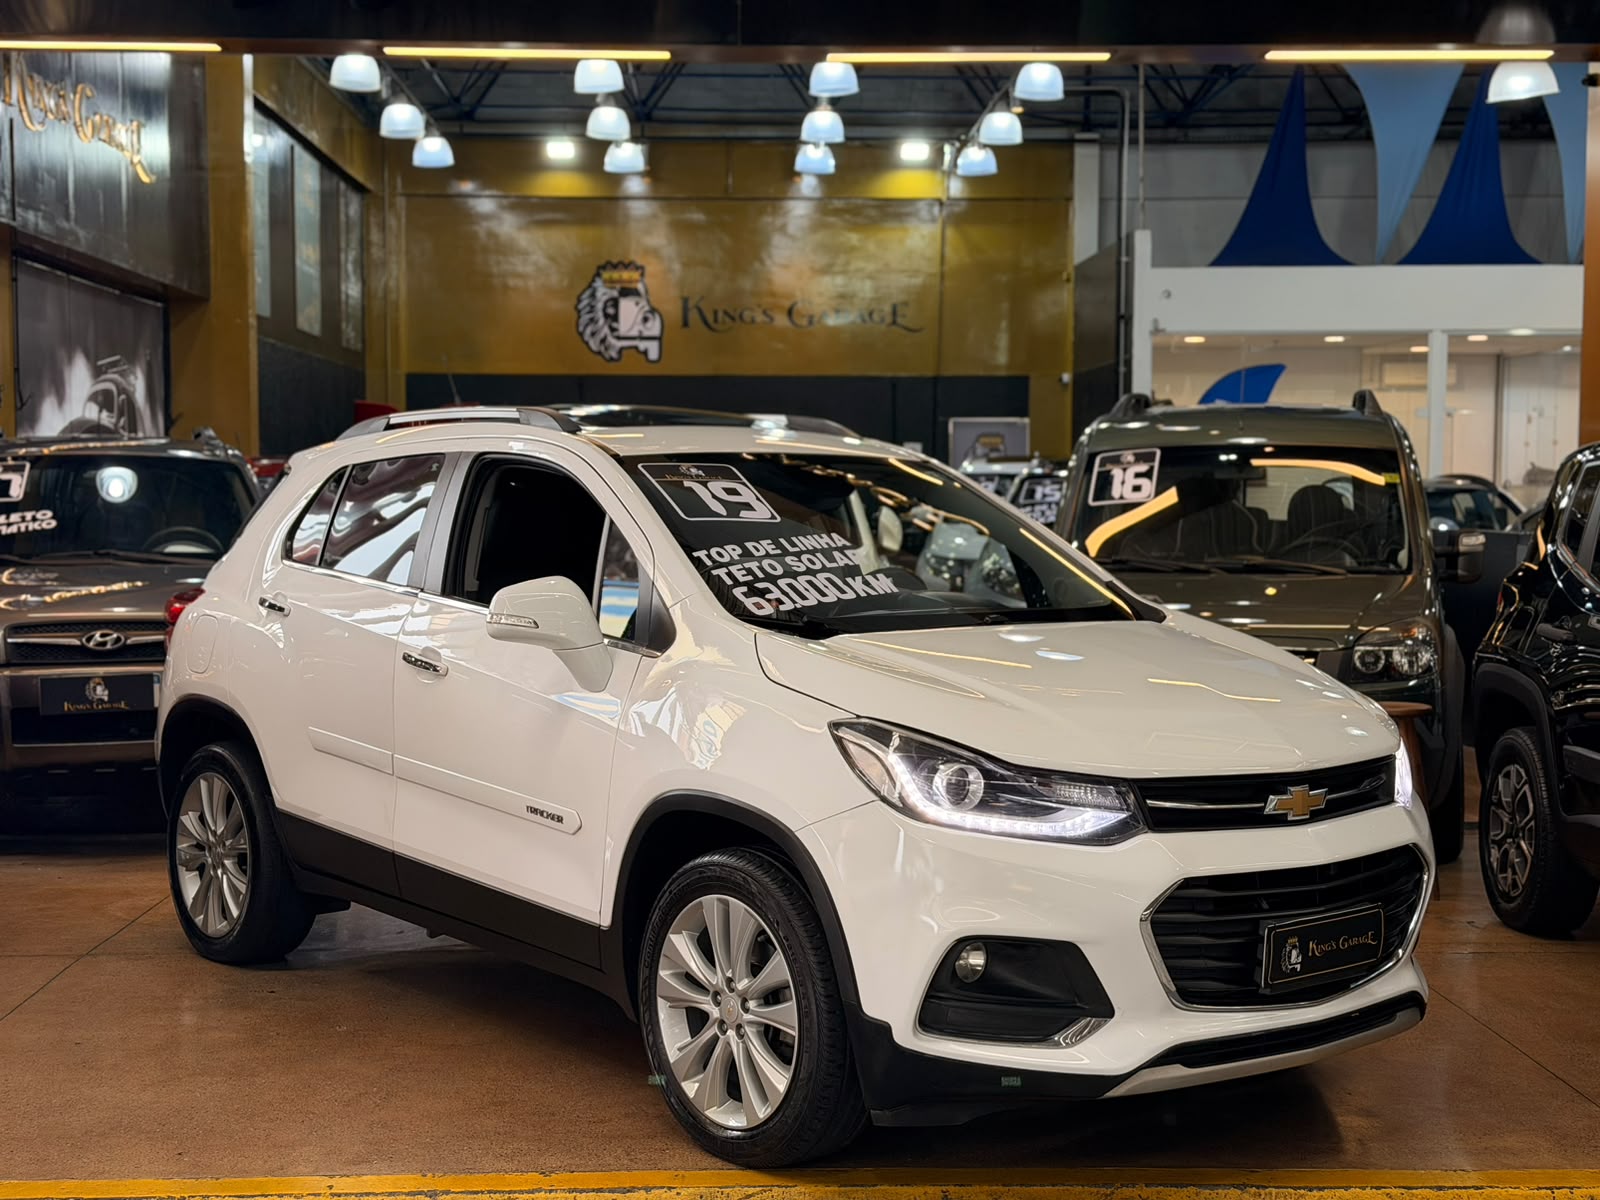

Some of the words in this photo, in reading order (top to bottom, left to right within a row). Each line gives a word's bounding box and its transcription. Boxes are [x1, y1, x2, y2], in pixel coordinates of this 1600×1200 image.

[681, 296, 775, 333] KING'S
[1034, 485, 1062, 502] 15
[1110, 464, 1152, 500] 16
[683, 481, 772, 519] 19
[692, 544, 743, 566] TOP
[744, 539, 782, 557] DE
[778, 532, 852, 551] LINHA
[711, 558, 784, 586] TETO
[525, 804, 565, 825] TRACKER
[1308, 940, 1337, 957] KING'S
[1340, 932, 1378, 948] GARAGE
